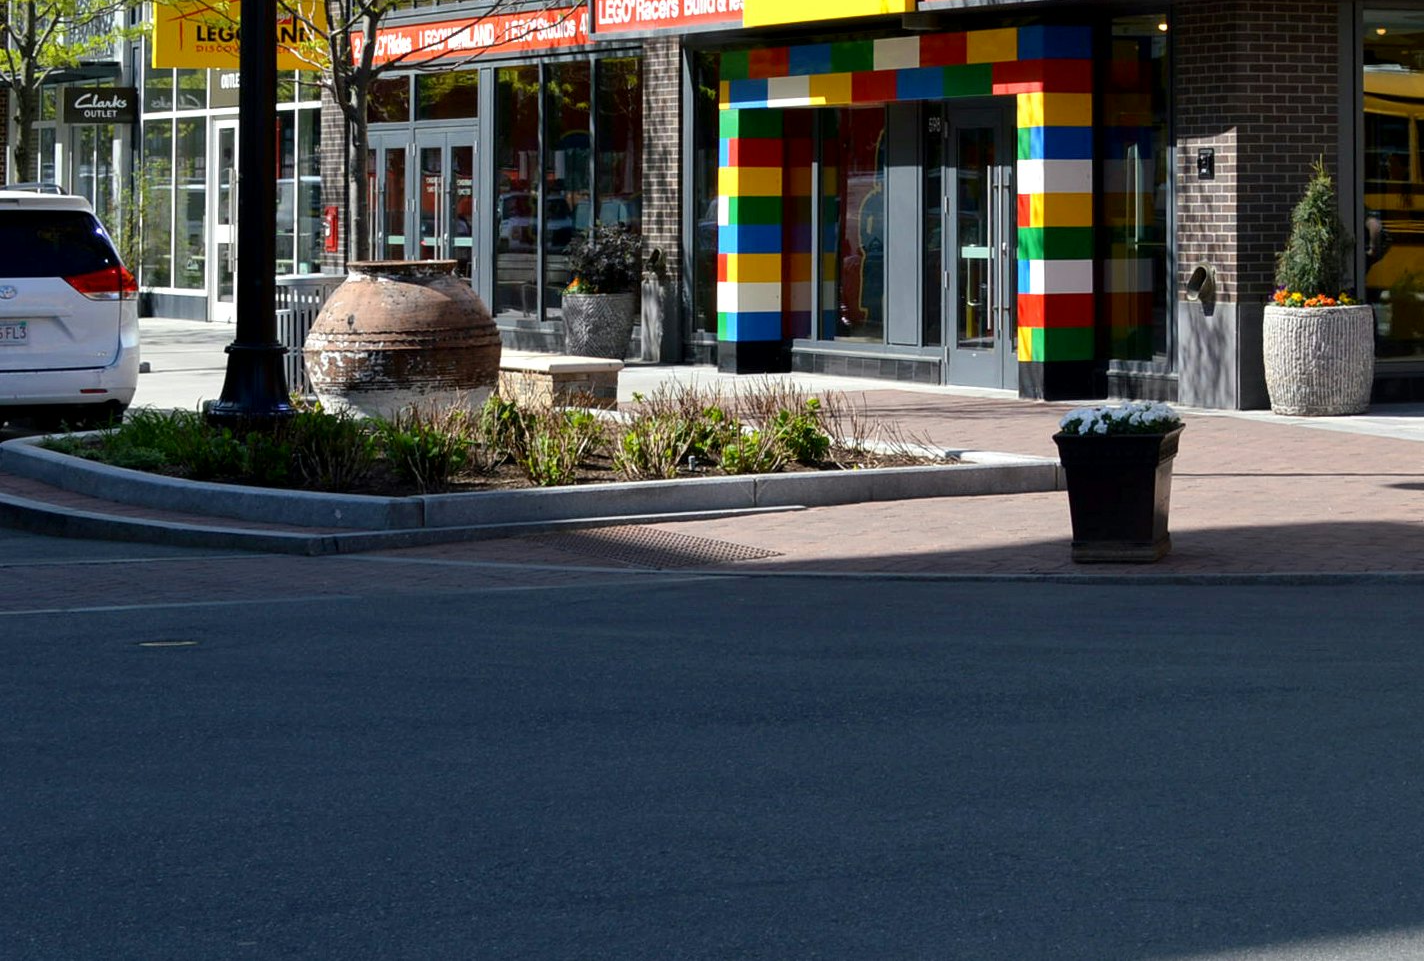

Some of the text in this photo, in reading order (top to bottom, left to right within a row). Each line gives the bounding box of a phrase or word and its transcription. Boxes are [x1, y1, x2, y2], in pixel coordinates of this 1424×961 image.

[221, 72, 240, 89] OUTLE
[74, 93, 127, 108] Clarks
[84, 109, 118, 118] OUTLET
